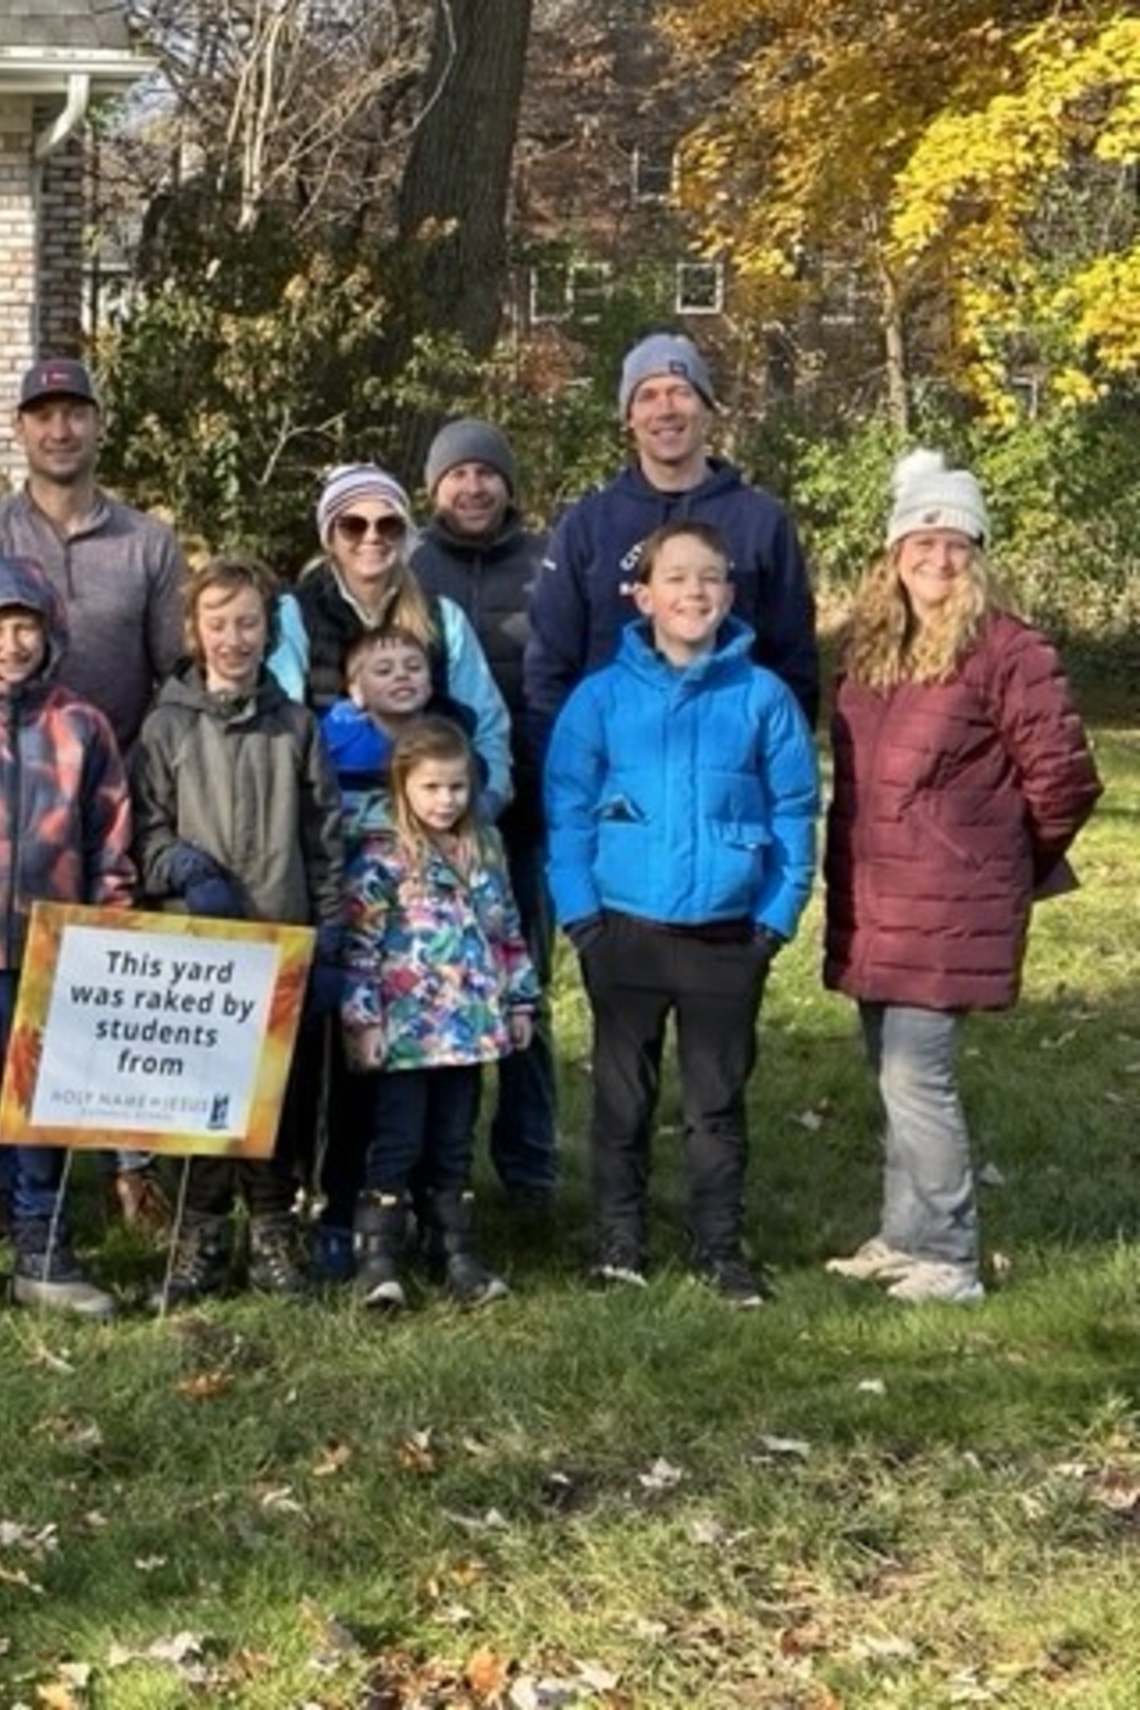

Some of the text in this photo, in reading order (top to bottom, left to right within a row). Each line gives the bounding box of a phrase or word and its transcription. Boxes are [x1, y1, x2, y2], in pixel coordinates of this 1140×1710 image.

[106, 951, 235, 986] This yard
[70, 985, 254, 1024] was raked by
[96, 1018, 218, 1048] students
[116, 1050, 184, 1076] from
